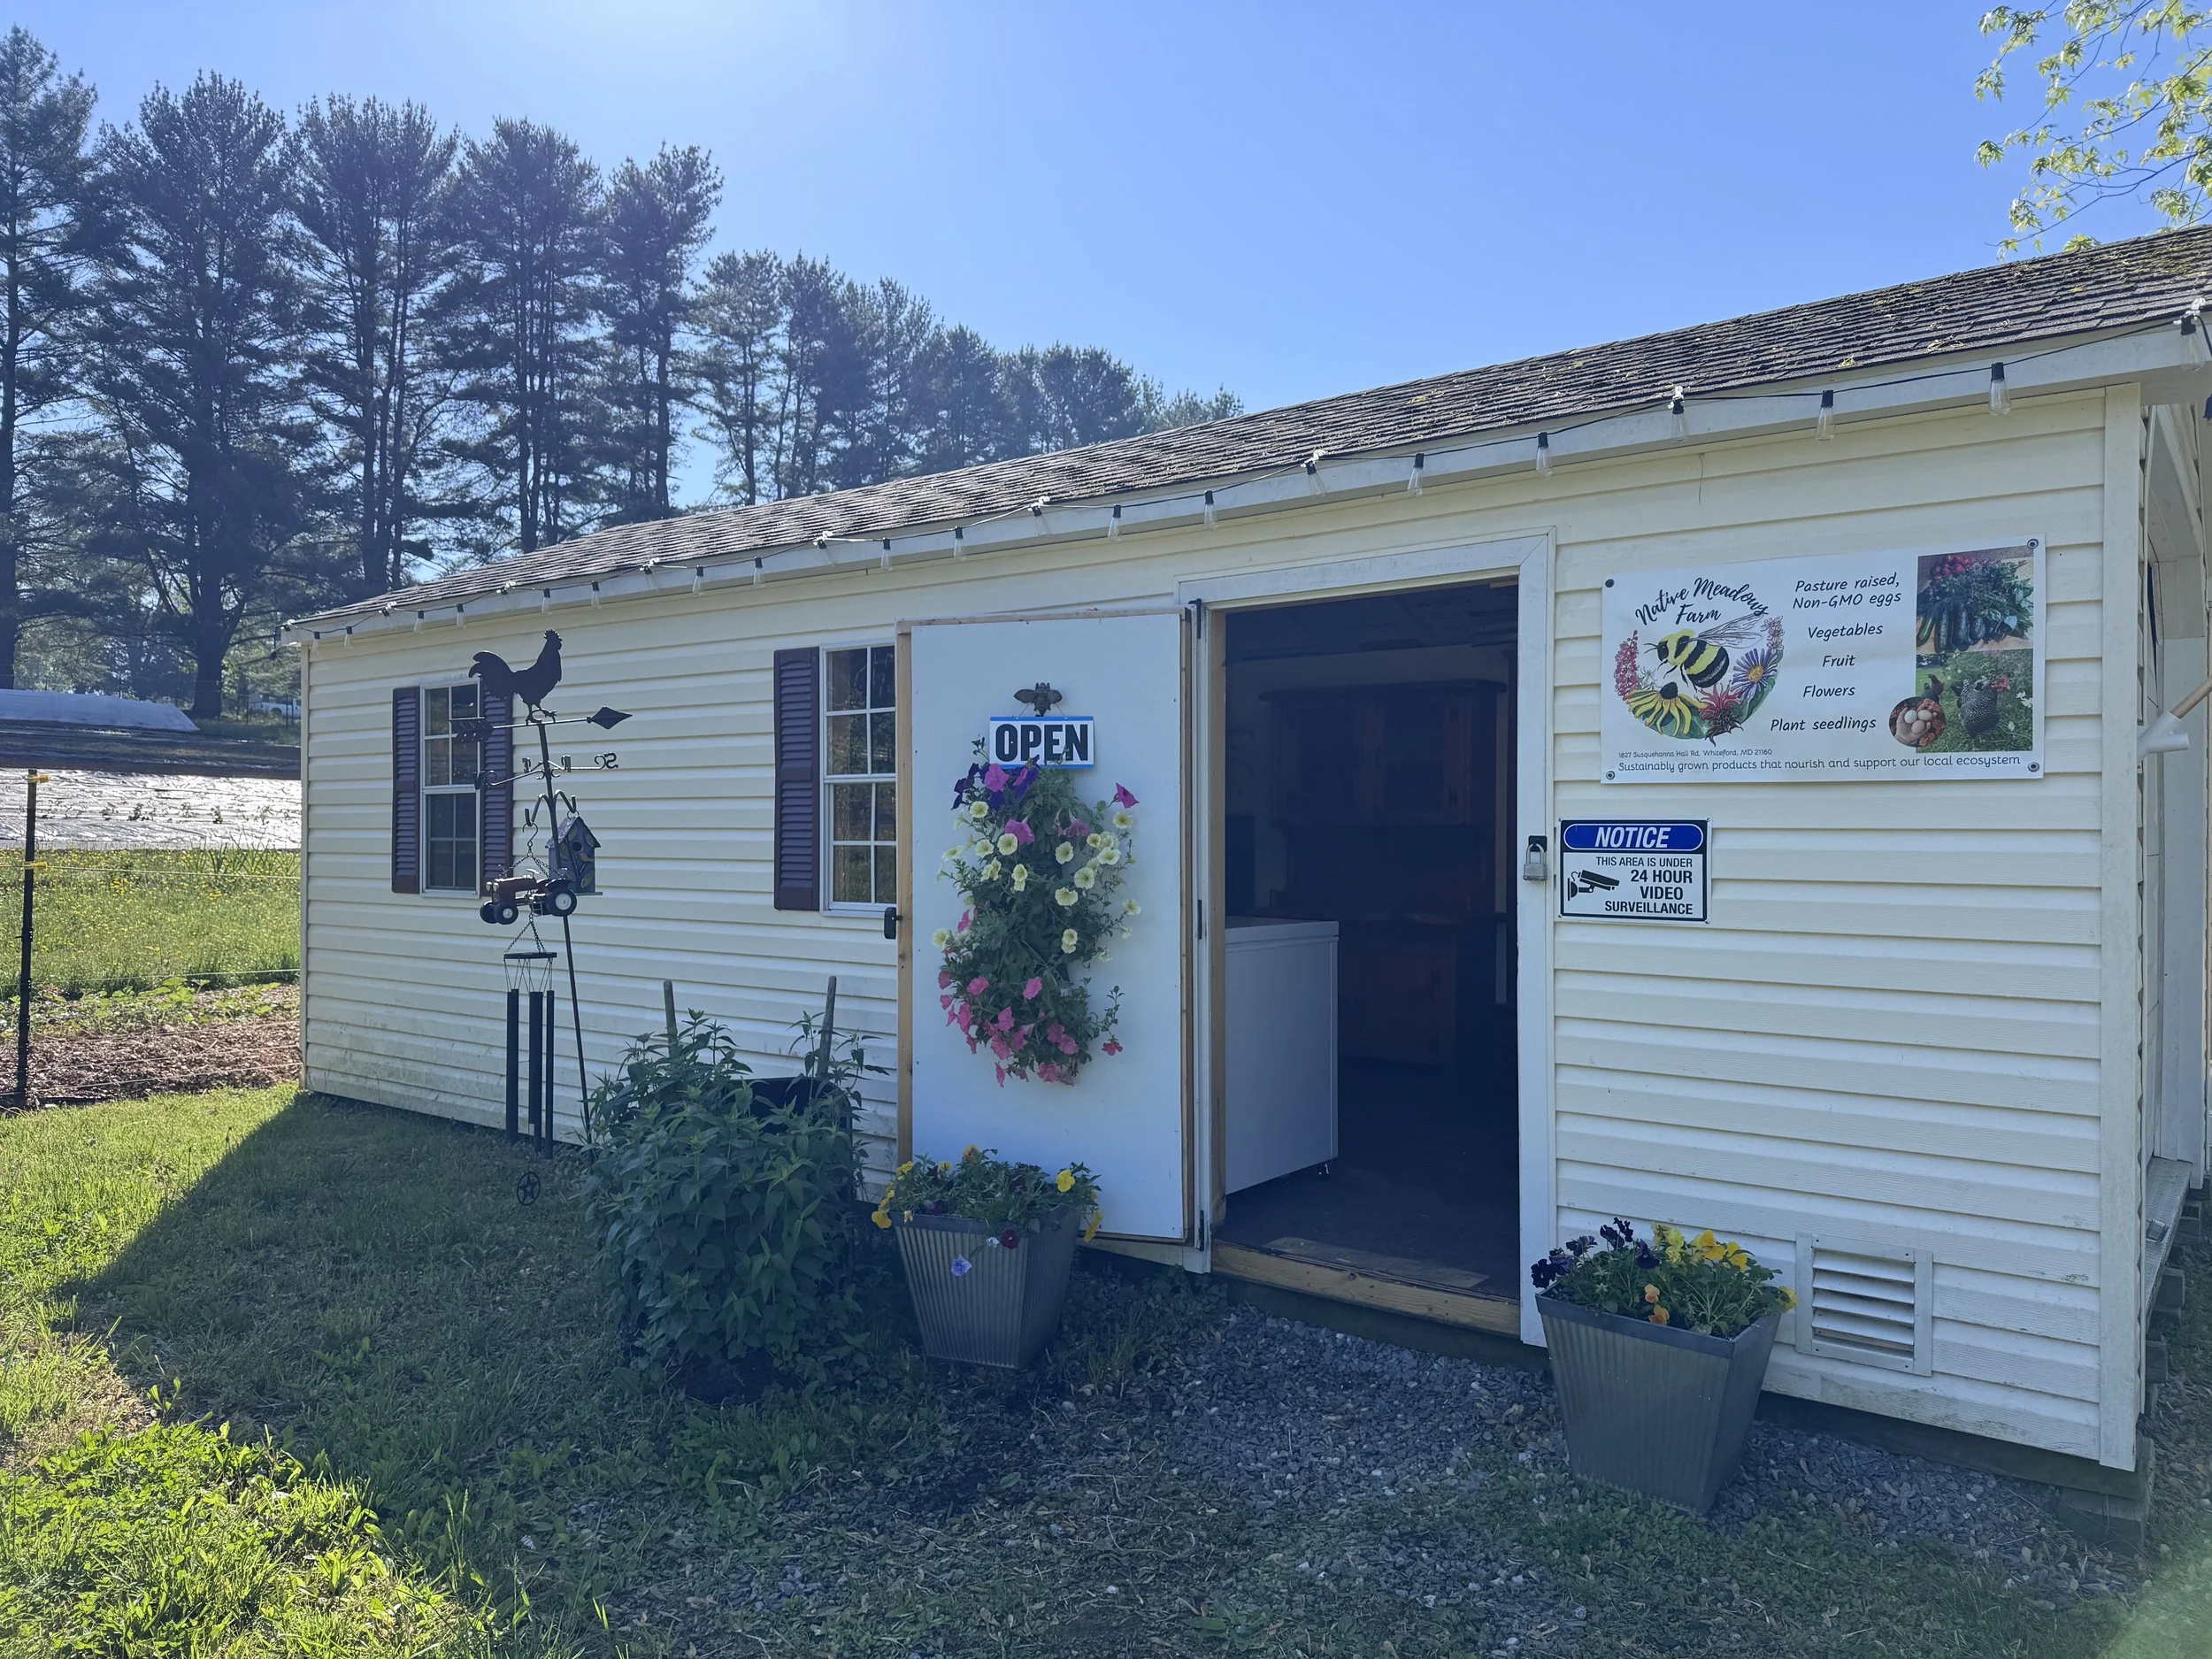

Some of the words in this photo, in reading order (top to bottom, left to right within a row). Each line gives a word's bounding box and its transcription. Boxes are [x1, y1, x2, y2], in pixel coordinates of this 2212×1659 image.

[1795, 580, 1847, 592] Pasture
[1855, 572, 1900, 589] raised,
[1635, 588, 1689, 626] Native
[1694, 577, 1769, 616] Meadows
[1793, 593, 1863, 609] Non-GMO
[1870, 592, 1901, 607] eggs
[1675, 603, 1722, 625] Farm
[1808, 622, 1883, 641] Vegetables
[1822, 655, 1855, 667] Fruit
[1802, 685, 1855, 698] Flowers
[1770, 718, 1806, 732] Plant
[1812, 716, 1877, 733] seedlings
[995, 723, 1088, 762] OPEN
[1633, 750, 1674, 759] Susquehanna
[1618, 761, 1675, 772] Sustainably
[1678, 762, 1709, 772] grown
[1712, 760, 1757, 772] products
[1760, 759, 1782, 769] that
[1785, 758, 1824, 769] nourish
[1828, 757, 1850, 768] and
[1854, 757, 1896, 770] support
[1900, 757, 1920, 766] our
[1924, 756, 1953, 766] local
[1956, 756, 2021, 768] ecosystem
[1595, 826, 1671, 849] NOTICE
[1596, 856, 1617, 866] THIS
[1619, 857, 1644, 867] AREA
[1647, 857, 1656, 867] IS
[1659, 857, 1693, 868] UNDER
[1631, 870, 1647, 882] 24
[1653, 870, 1693, 883] HOUR
[1640, 886, 1683, 900] VIDEO
[1605, 901, 1694, 915] SURVEILLANCE
